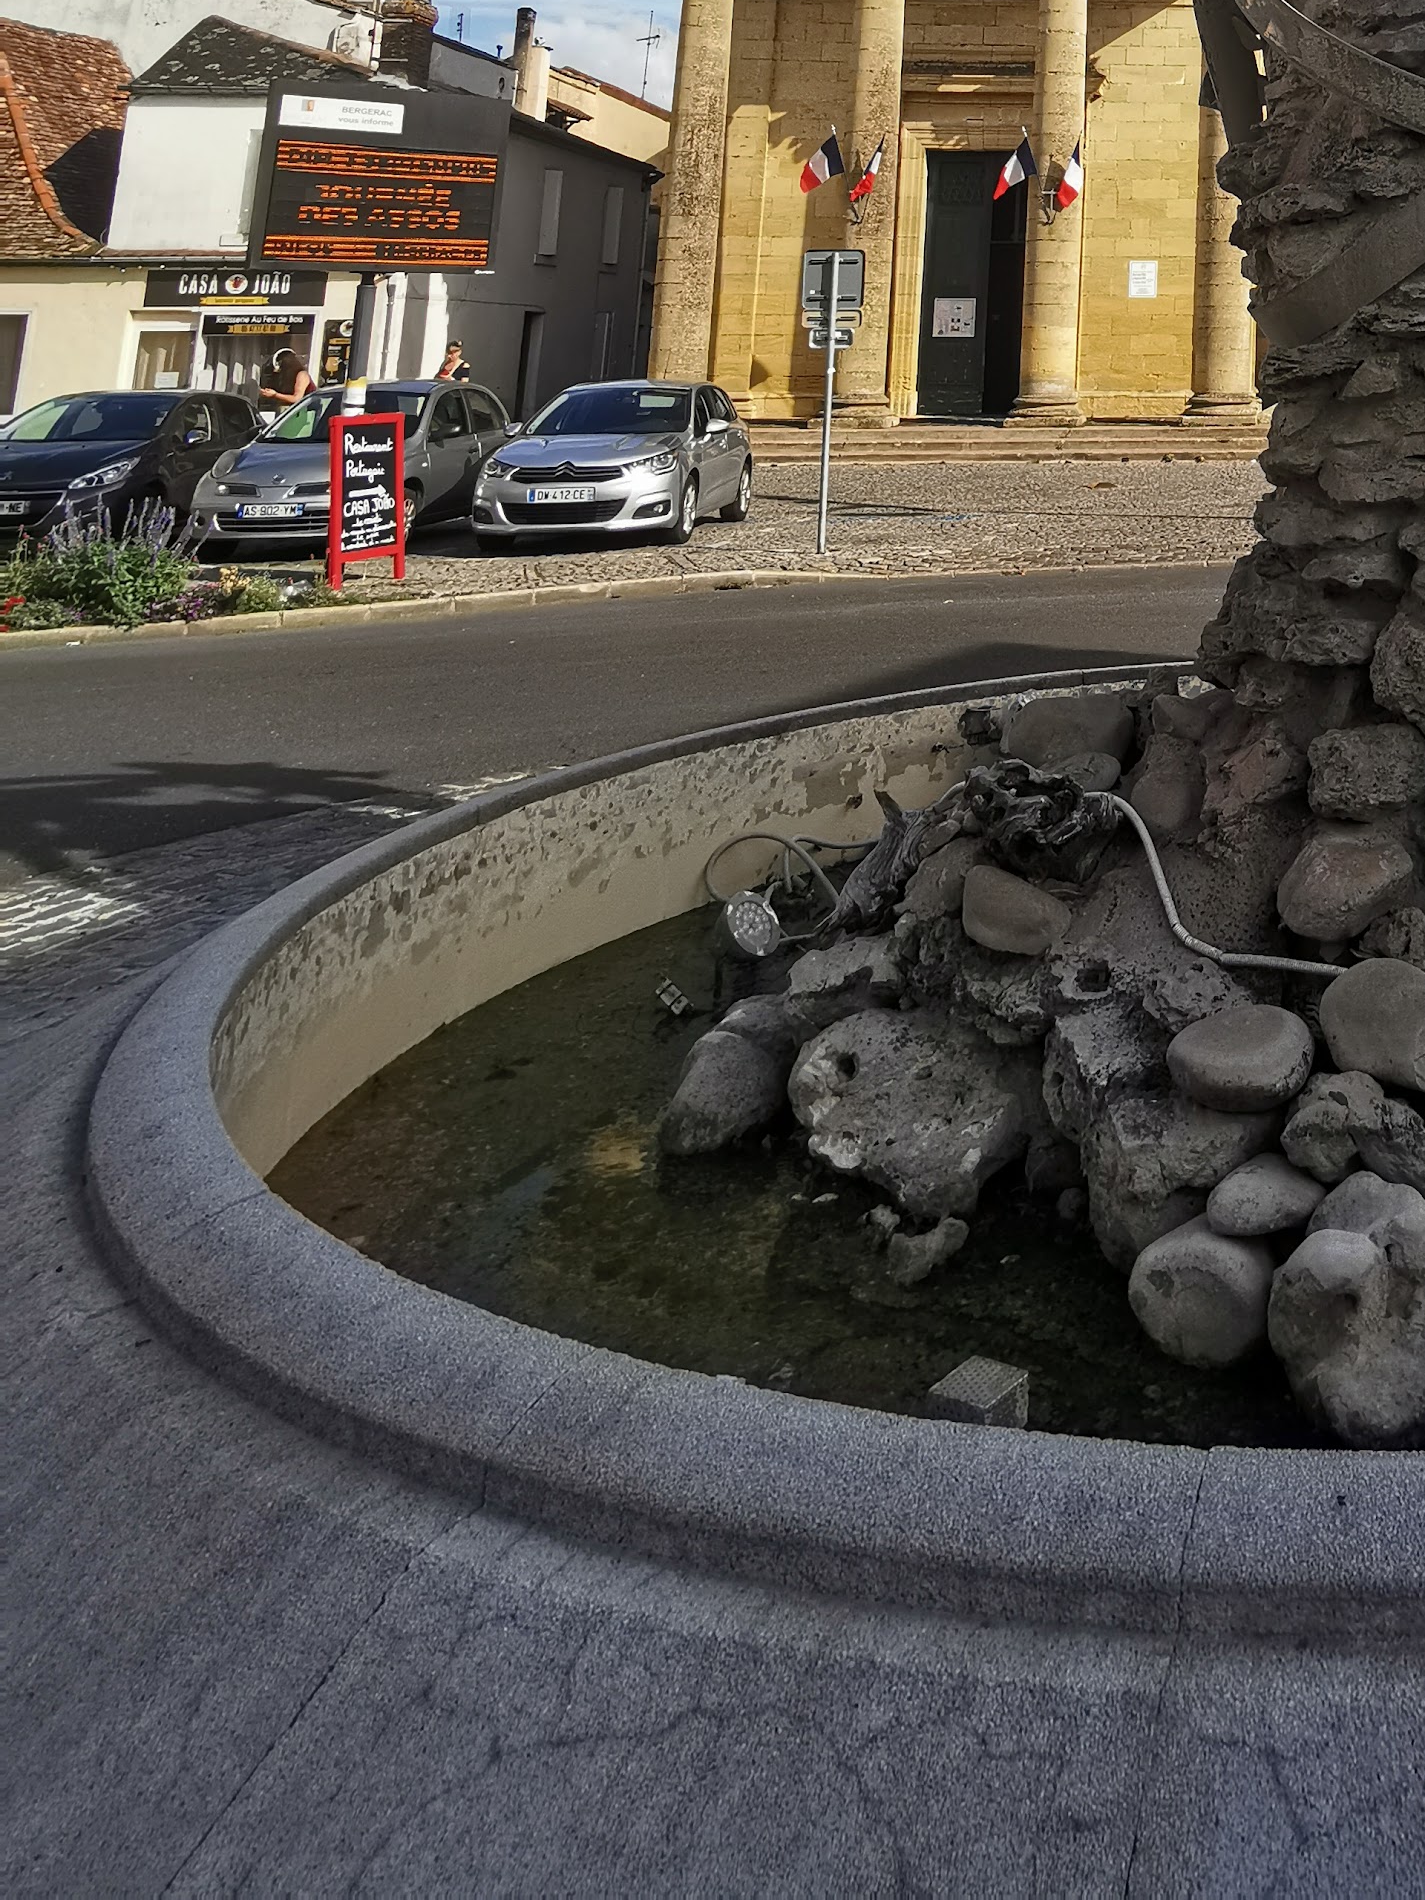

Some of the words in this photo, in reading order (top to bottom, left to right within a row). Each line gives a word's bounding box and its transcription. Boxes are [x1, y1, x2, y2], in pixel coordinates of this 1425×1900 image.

[342, 106, 392, 117] BERGERAC
[361, 118, 394, 127] informe
[179, 274, 218, 294] CASA
[252, 271, 291, 295] JOÃO
[343, 498, 370, 518] CASA
